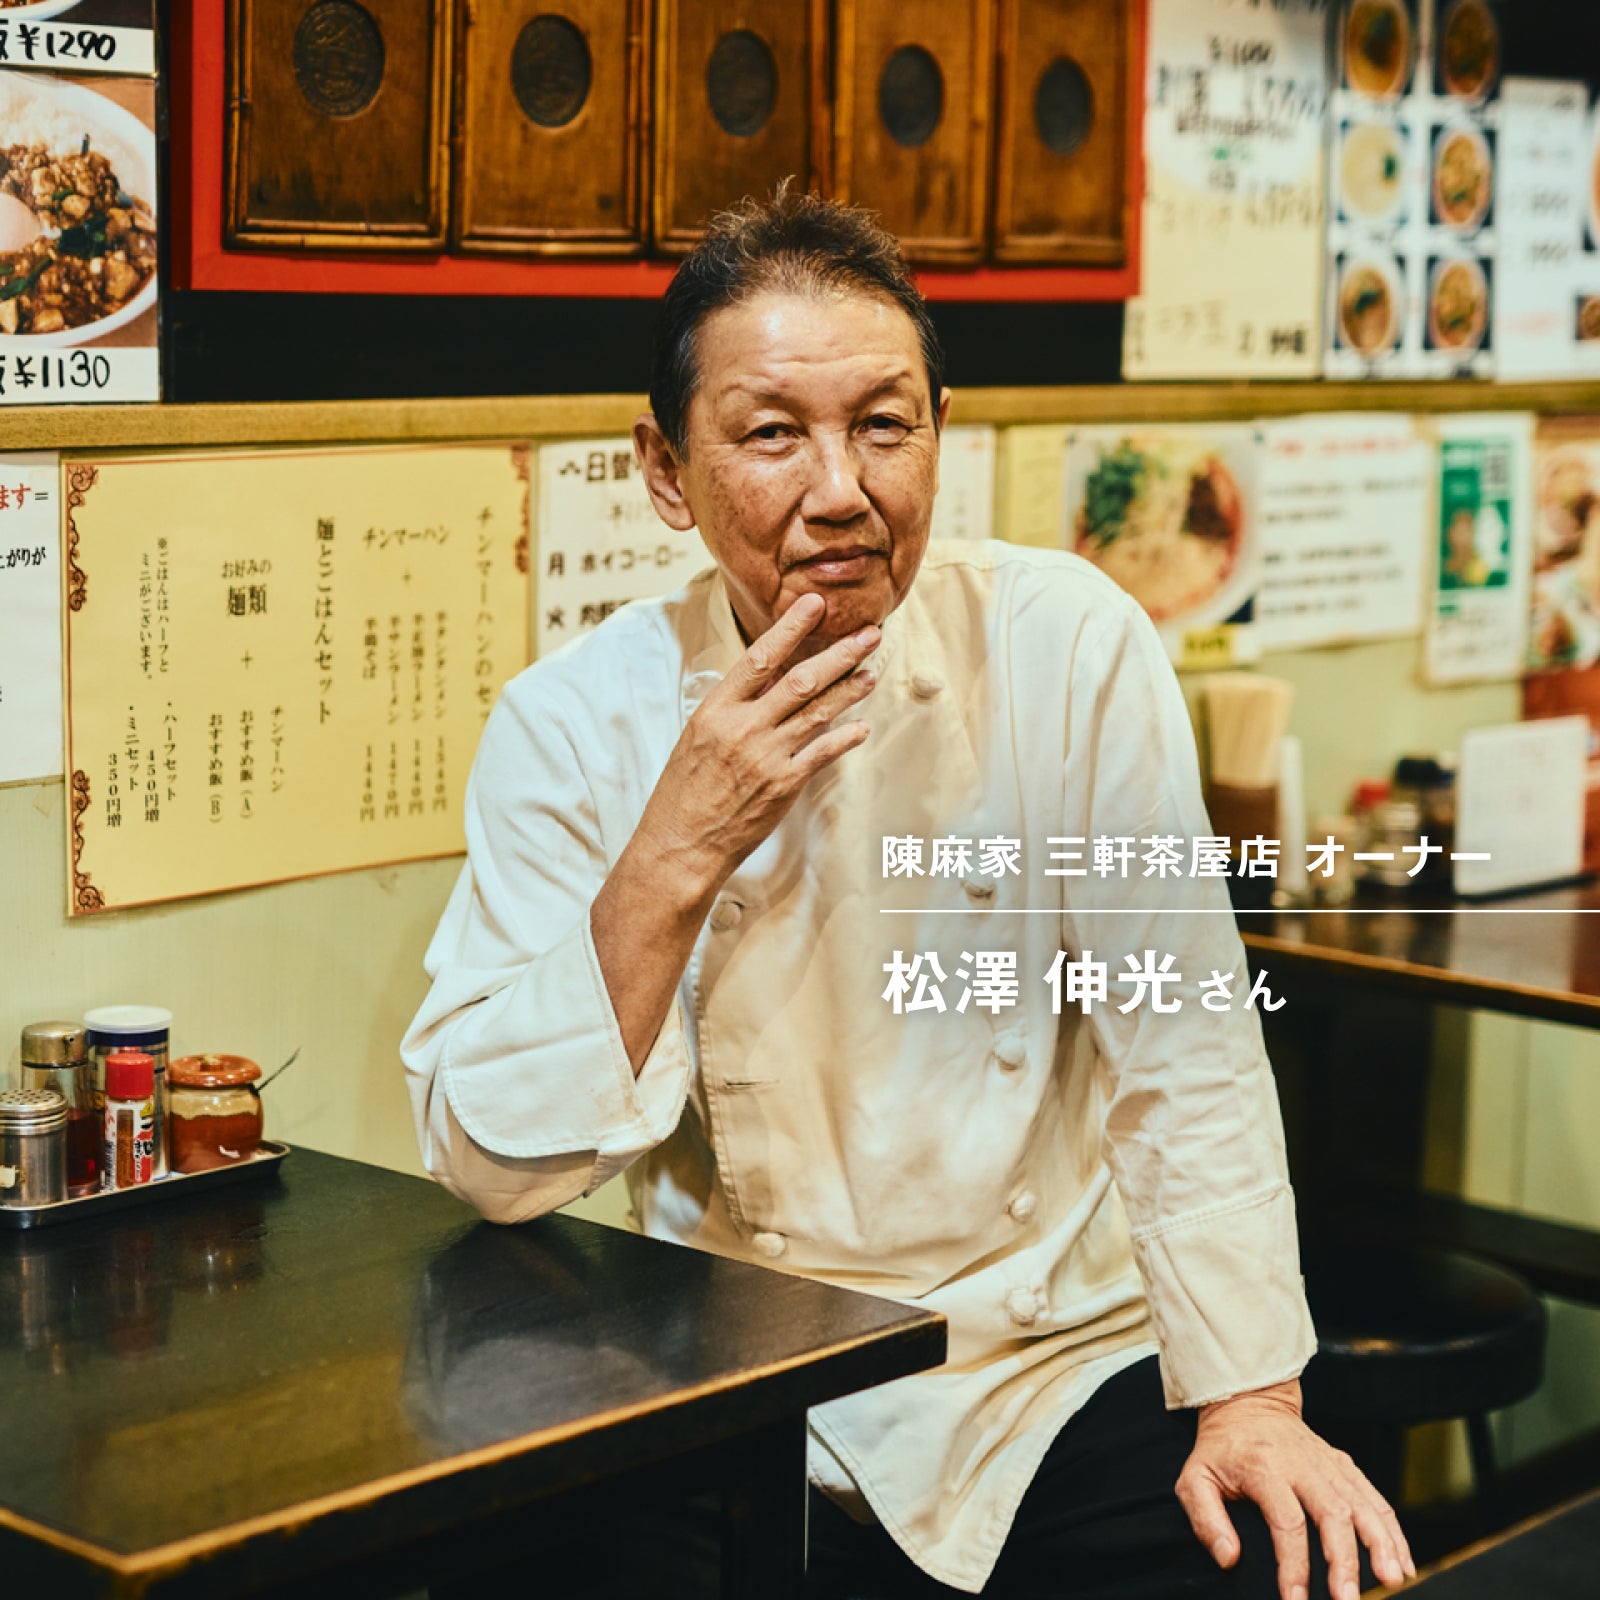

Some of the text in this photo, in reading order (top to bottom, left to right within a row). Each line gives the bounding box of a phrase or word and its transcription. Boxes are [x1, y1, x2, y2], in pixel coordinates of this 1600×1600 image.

[363, 525, 449, 549] チンマーハン
[221, 558, 272, 578] お好みの
